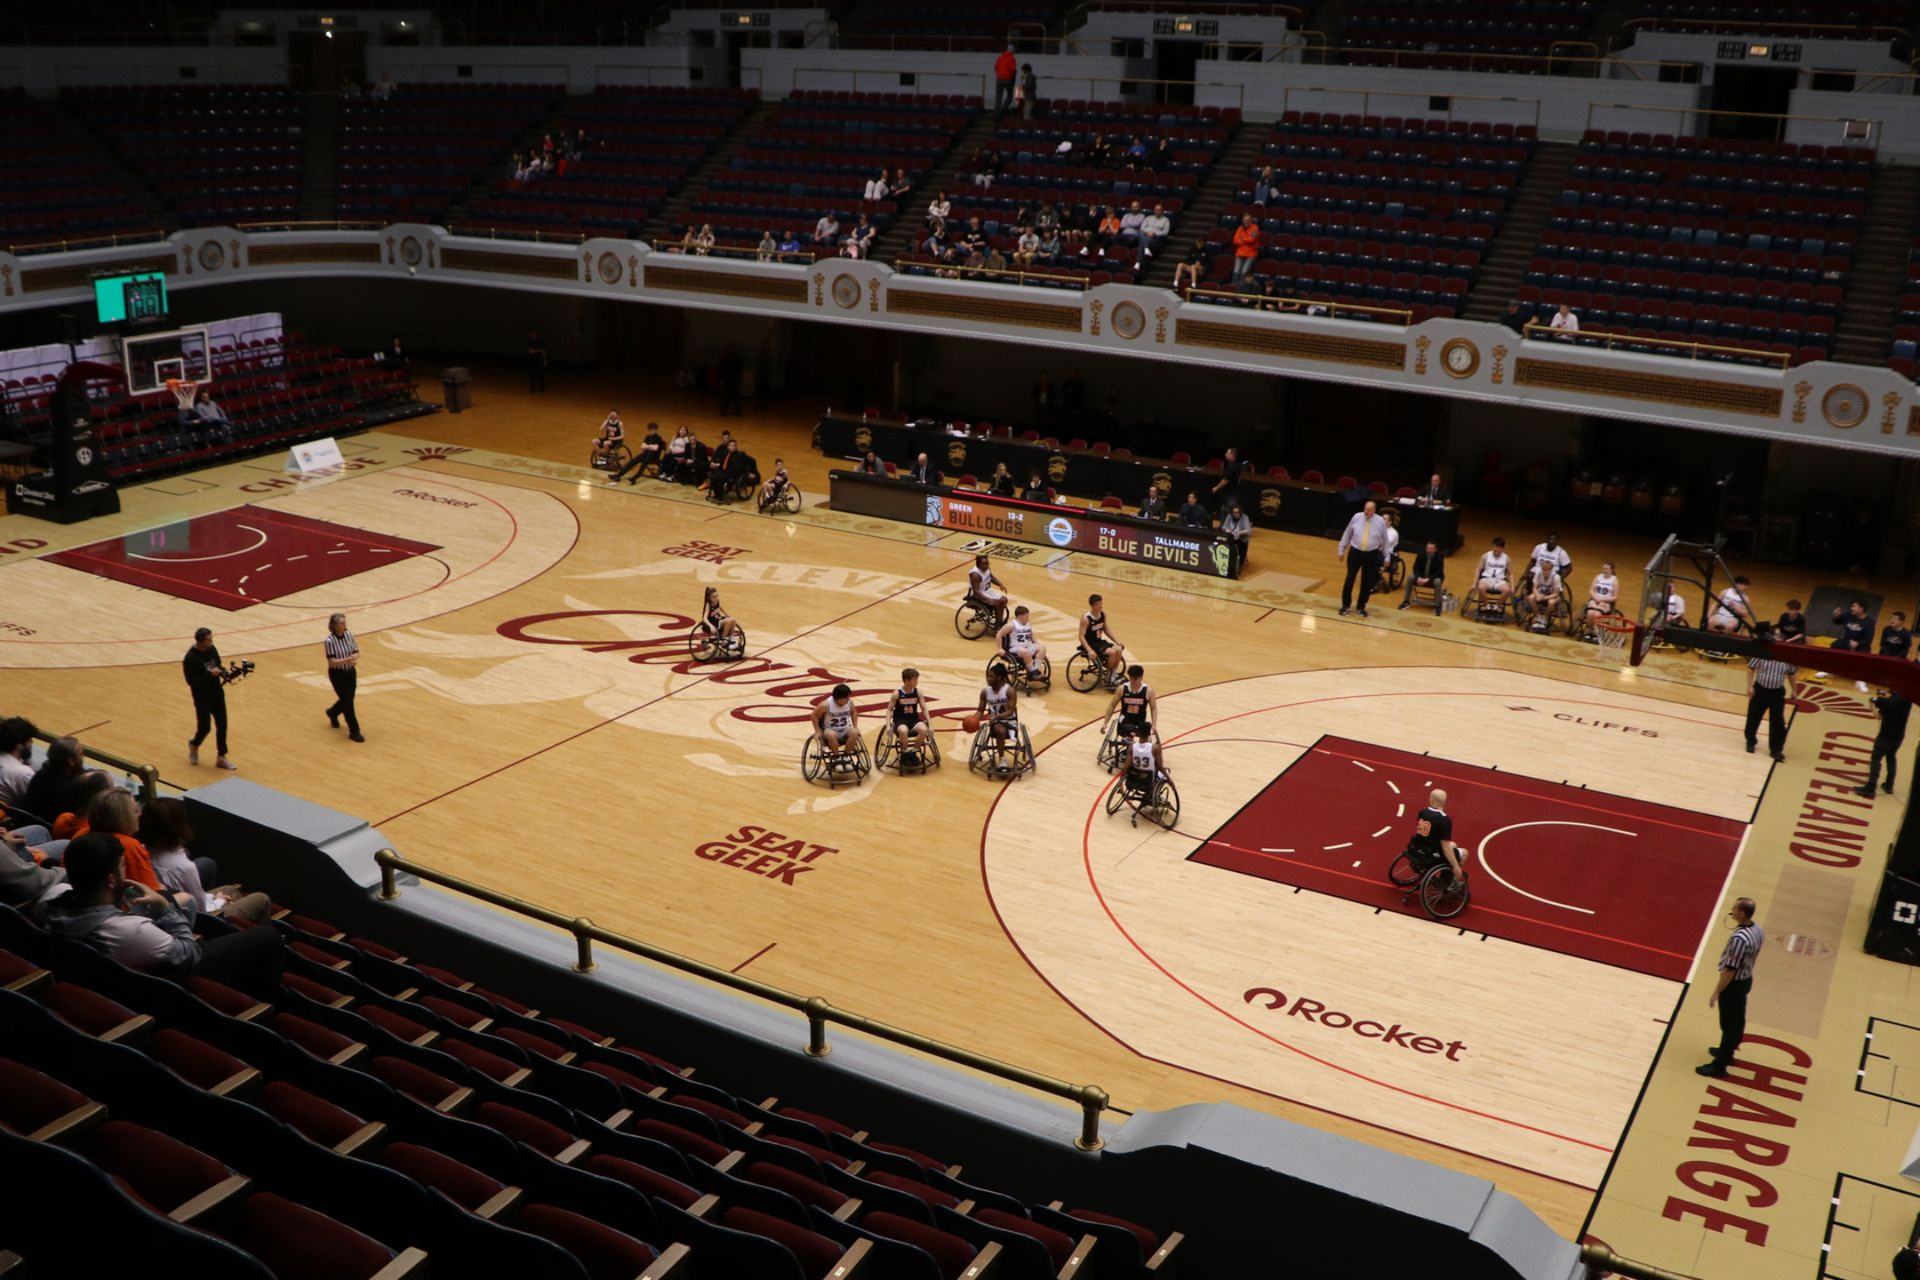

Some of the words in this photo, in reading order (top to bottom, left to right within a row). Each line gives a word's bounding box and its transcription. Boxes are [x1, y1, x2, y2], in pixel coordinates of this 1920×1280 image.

[239, 457, 385, 493] CHARGE
[949, 502, 972, 512] GREEN
[1008, 512, 1024, 521] 13-2
[949, 511, 1023, 535] BULLDOGS
[1099, 527, 1116, 537] 17-0
[661, 546, 735, 565] GEEK
[681, 540, 752, 556] SEAT
[1098, 536, 1138, 555] BLUE
[1143, 543, 1200, 566] DEVILS
[1154, 536, 1200, 551] TALLMADGE
[830, 717, 848, 728] 23
[1553, 713, 1659, 738] CLIFFS
[1133, 756, 1150, 768] 33
[1789, 731, 1878, 868] CLEVELAND
[725, 825, 840, 863] SEAT
[694, 842, 816, 886] GEEK
[1286, 996, 1467, 1062] Rocket
[1661, 1033, 1813, 1247] CHARGE
